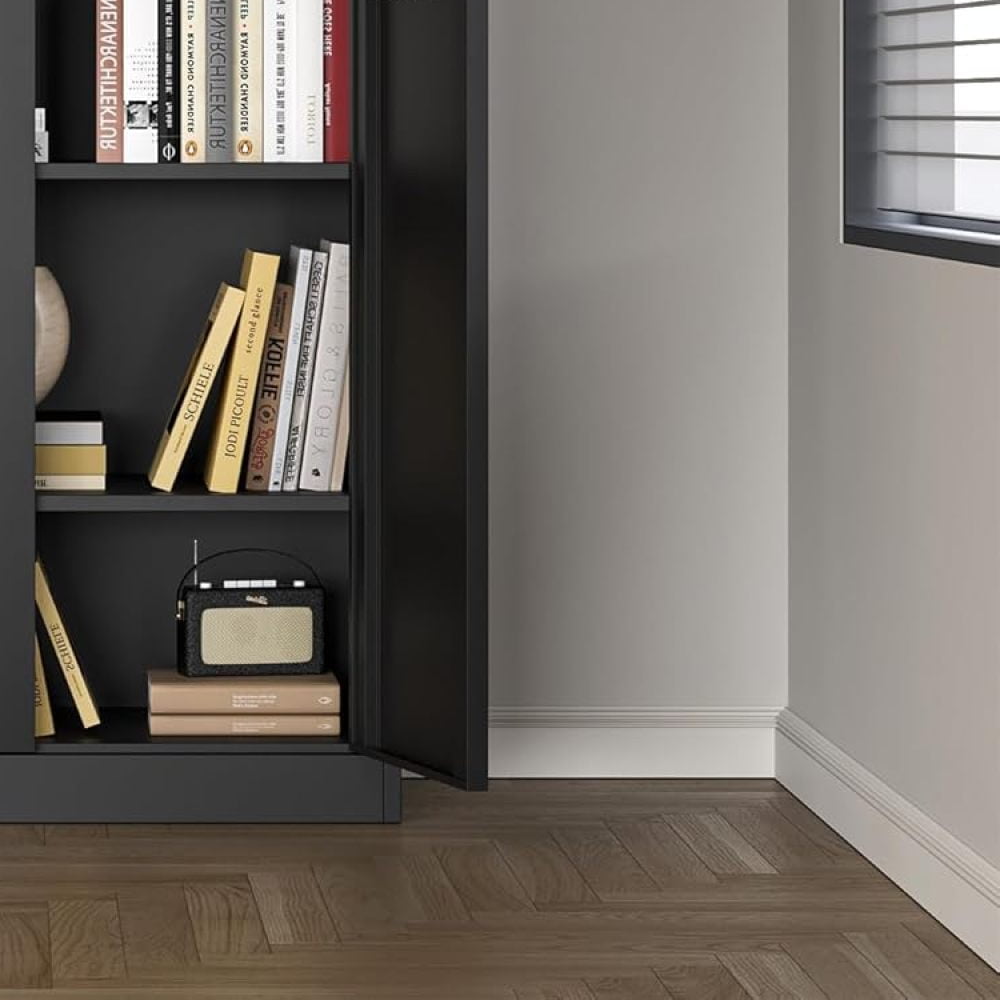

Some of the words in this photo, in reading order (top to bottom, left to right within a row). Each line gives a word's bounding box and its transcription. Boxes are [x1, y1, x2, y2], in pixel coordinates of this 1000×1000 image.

[246, 321, 257, 354] second
[252, 287, 264, 318] glance
[184, 361, 216, 422] SCHIELE
[231, 374, 250, 428] PICOULT
[224, 429, 239, 458] JODI
